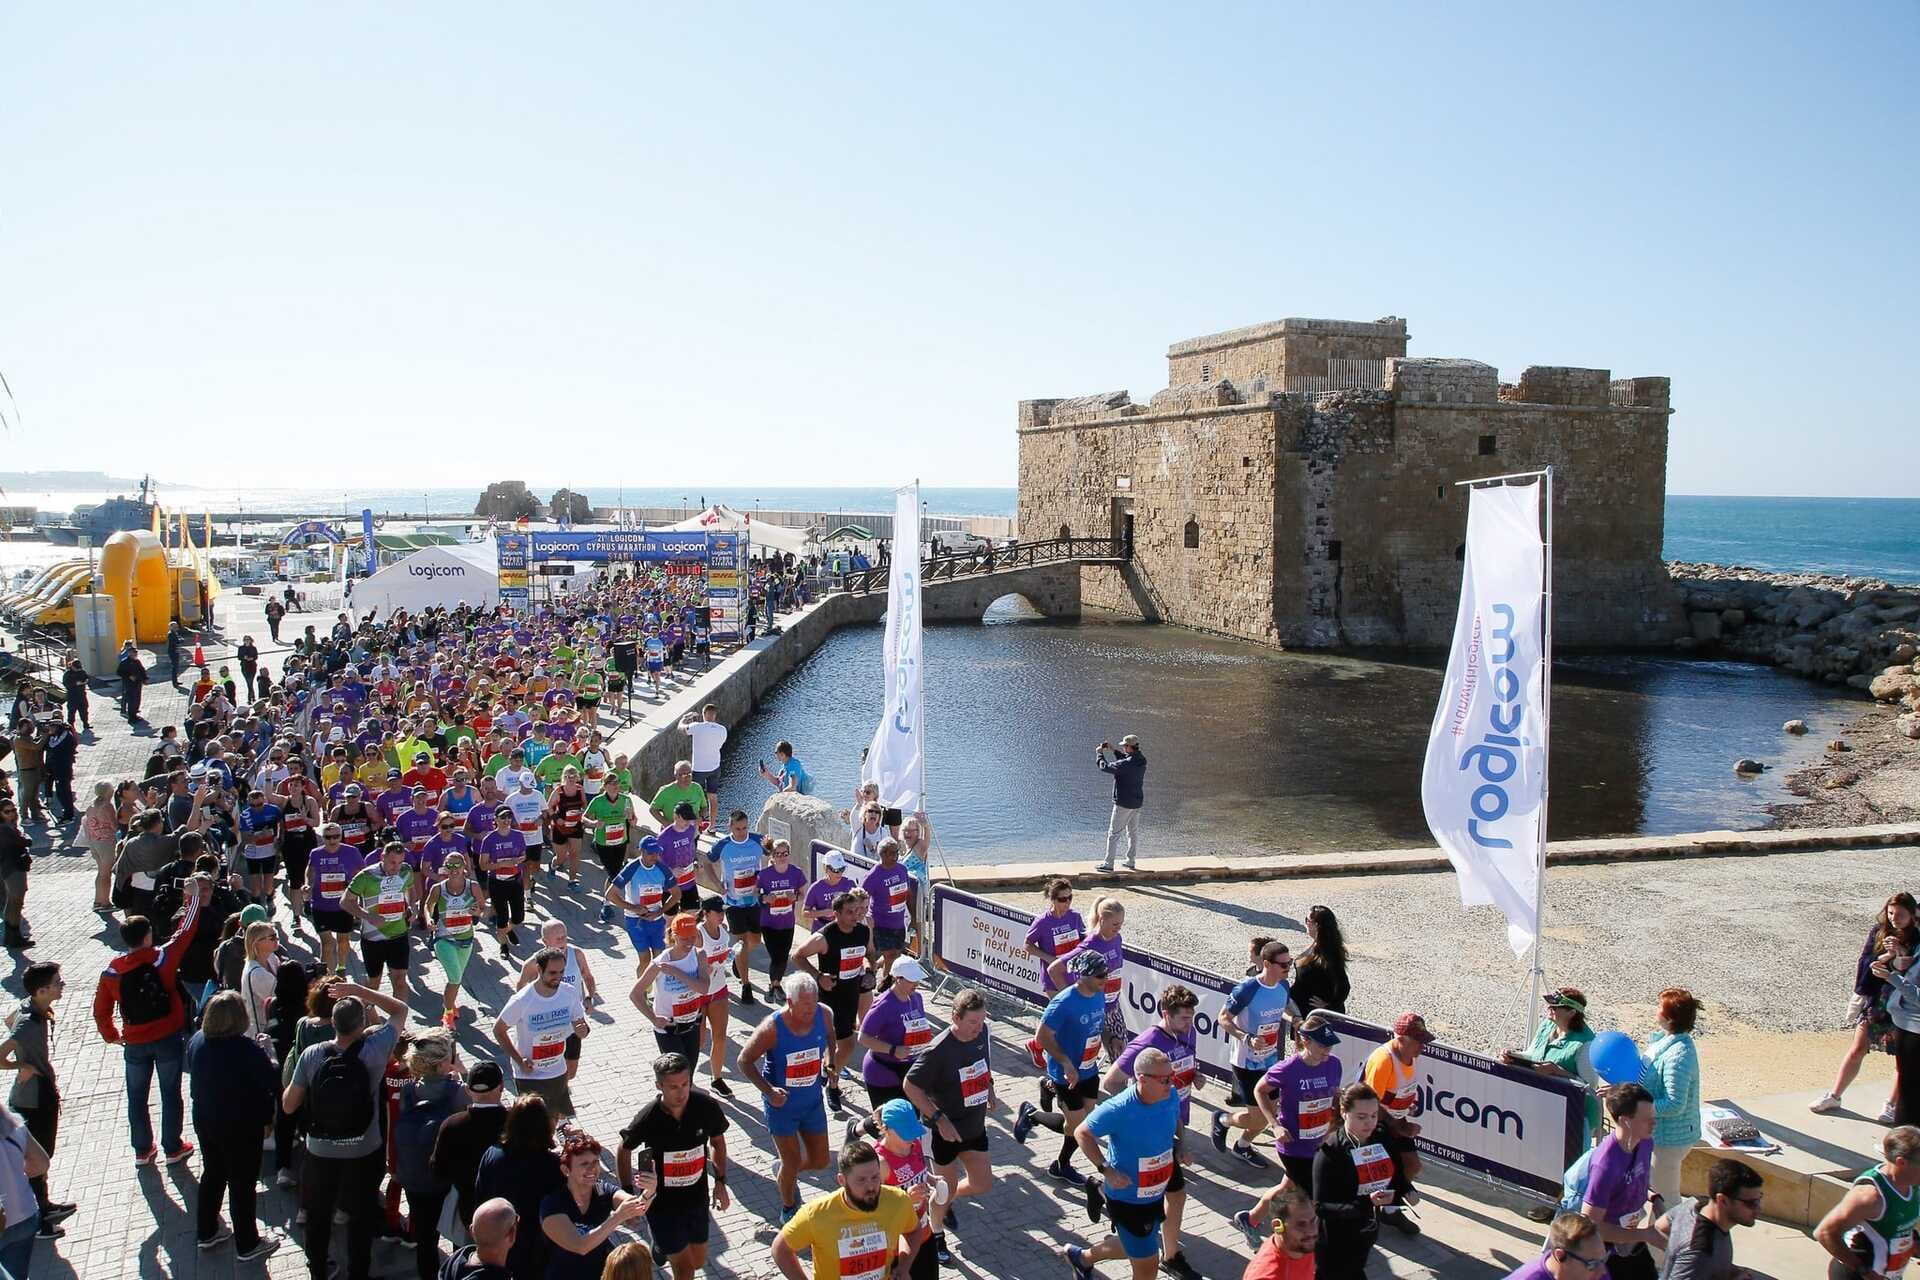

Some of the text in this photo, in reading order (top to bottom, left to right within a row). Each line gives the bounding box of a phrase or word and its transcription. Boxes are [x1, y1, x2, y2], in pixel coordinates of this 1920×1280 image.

[610, 535, 645, 543] LOGICOM
[365, 532, 373, 562] Logicom
[535, 541, 580, 555] Logicom
[586, 544, 656, 552] CYPRUS MARATHON
[662, 541, 707, 555] Logicom
[607, 552, 635, 561] START
[408, 563, 465, 580] Logicom
[730, 854, 757, 864] Logicom
[993, 906, 1009, 917] CYPRUS
[972, 916, 1010, 940] See you
[985, 938, 1007, 953] next
[983, 953, 1015, 975] MARCH
[1016, 966, 1040, 984] 2020!
[1150, 960, 1221, 989] LOGICOM CYPRUS MARATHON
[1451, 1052, 1491, 1071] MARATHON
